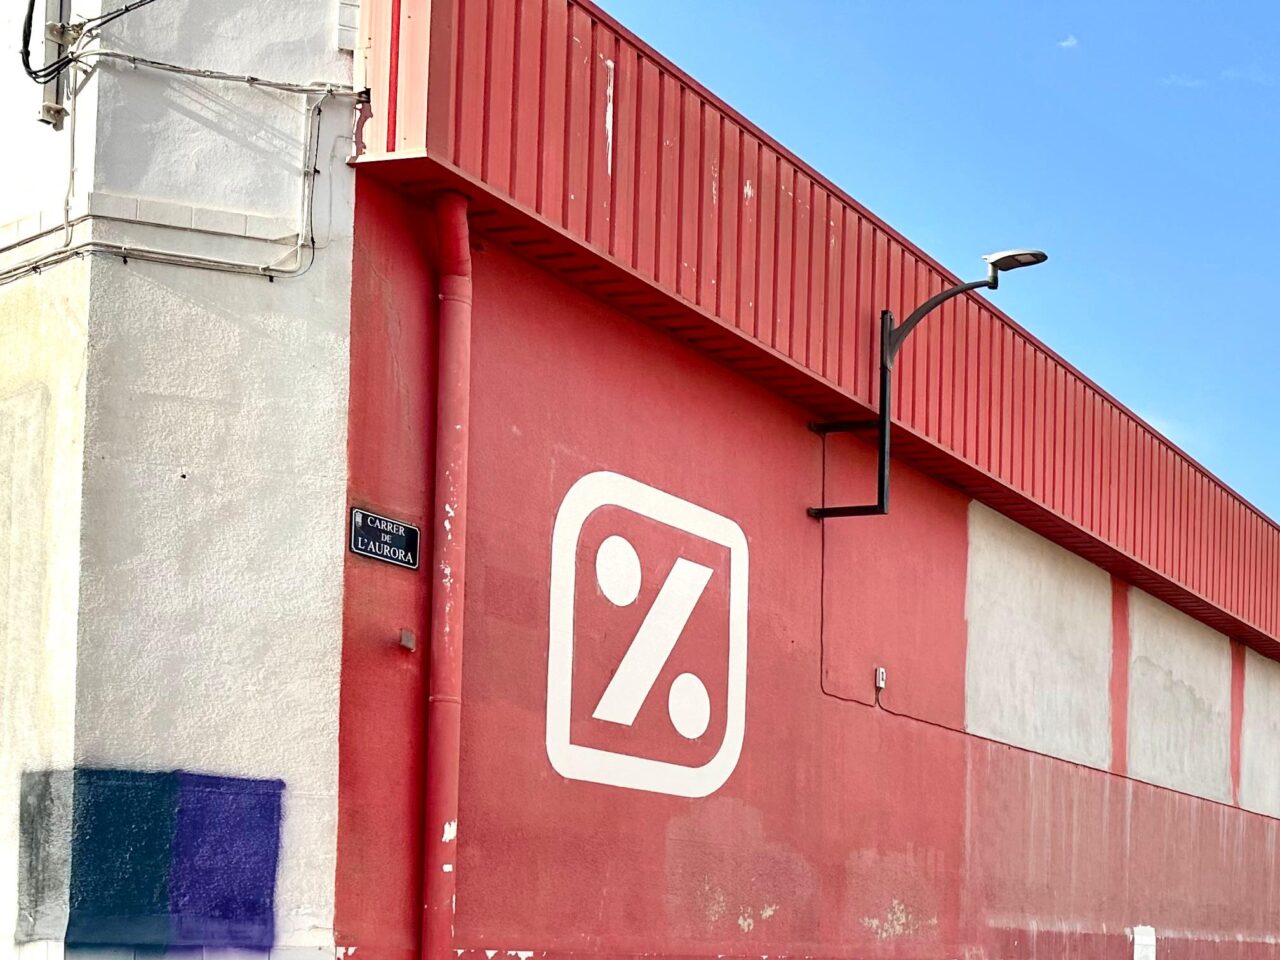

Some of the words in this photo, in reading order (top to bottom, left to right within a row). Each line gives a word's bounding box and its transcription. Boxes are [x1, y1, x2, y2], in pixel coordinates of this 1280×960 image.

[367, 516, 405, 536] CARRER
[381, 533, 392, 543] DE
[358, 537, 413, 564] L'AURORA
